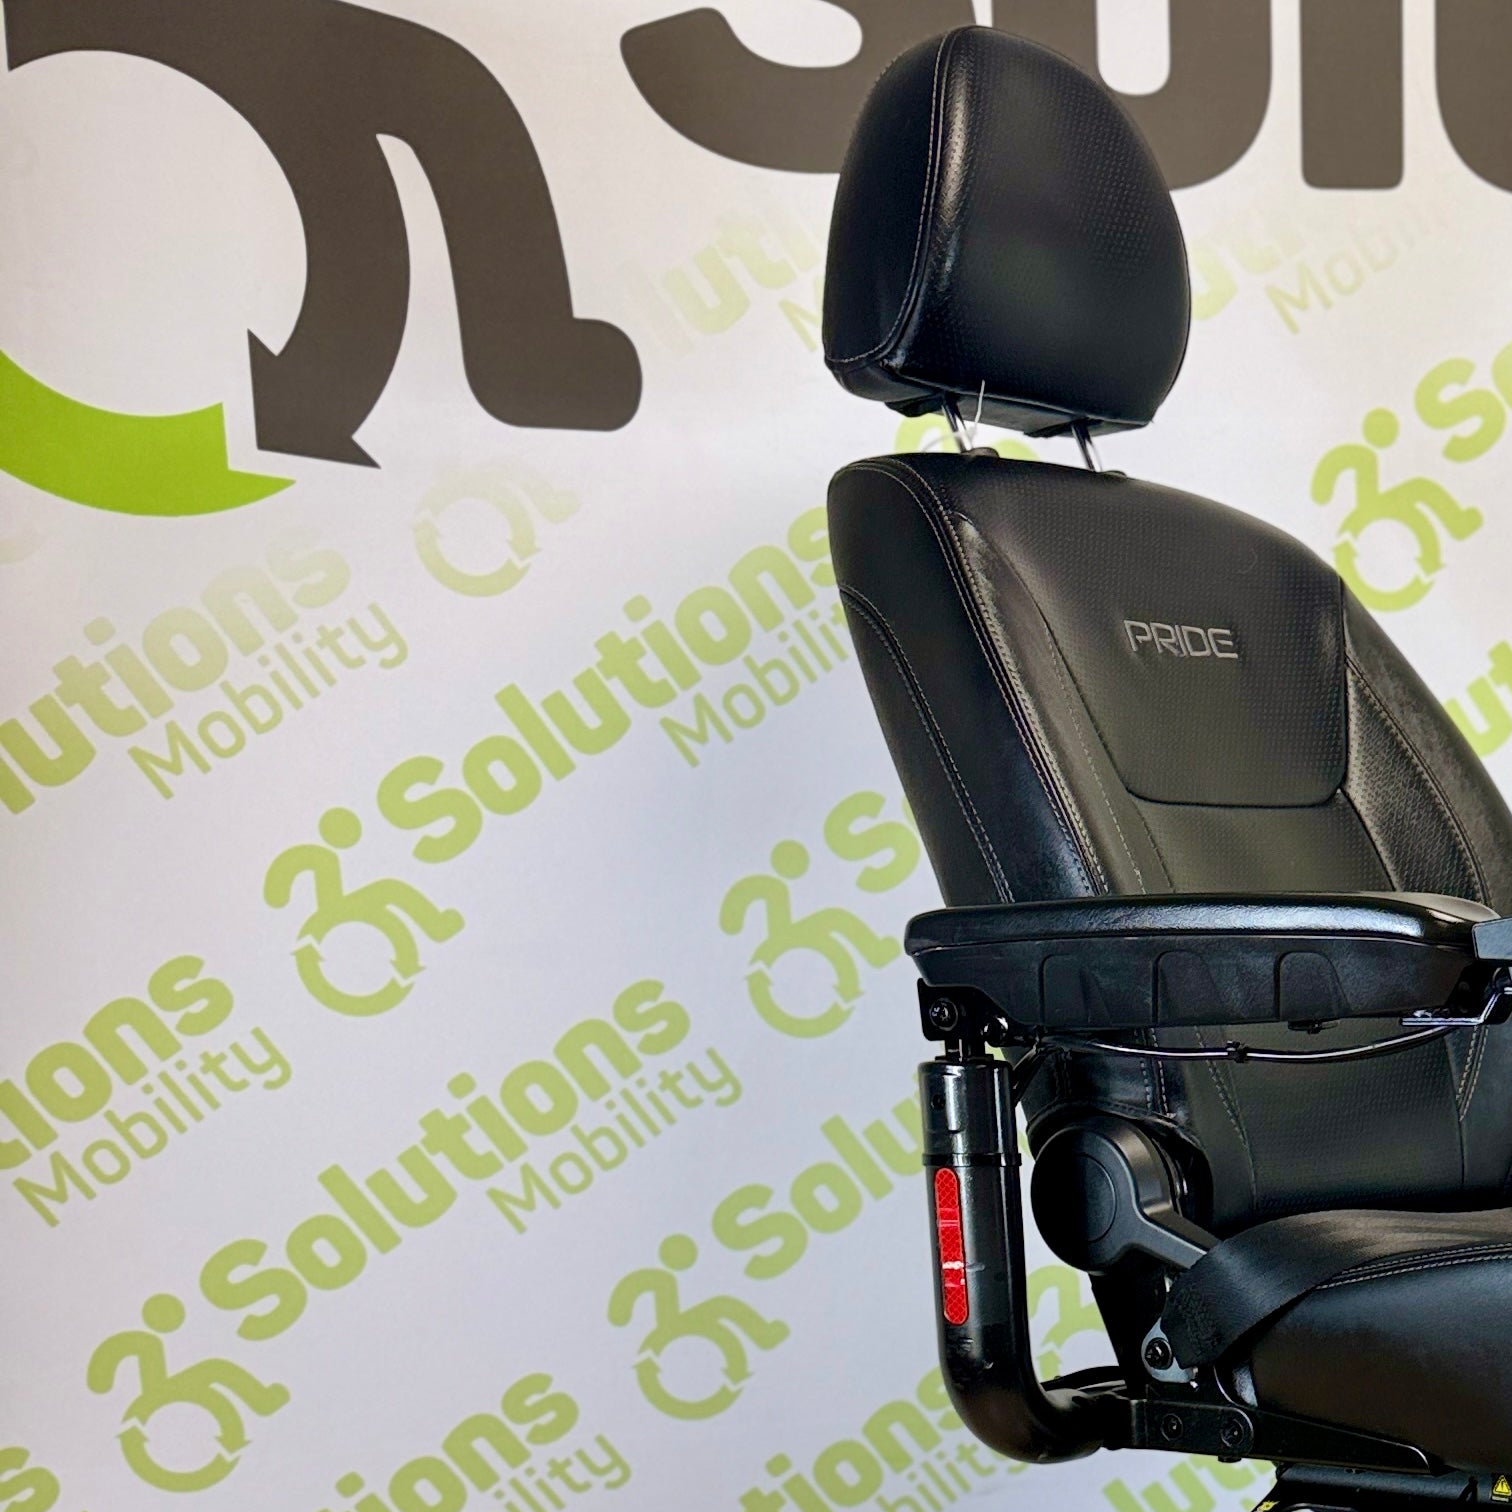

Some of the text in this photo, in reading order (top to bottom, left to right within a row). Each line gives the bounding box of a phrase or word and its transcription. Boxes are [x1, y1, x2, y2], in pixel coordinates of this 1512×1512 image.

[127, 602, 409, 801] Mobility
[659, 603, 850, 769] Mobili
[1123, 619, 1239, 659] PRIDE
[12, 1026, 292, 1227] Mobility
[199, 979, 691, 1340] Solutions
[486, 1046, 742, 1234] Mobility
